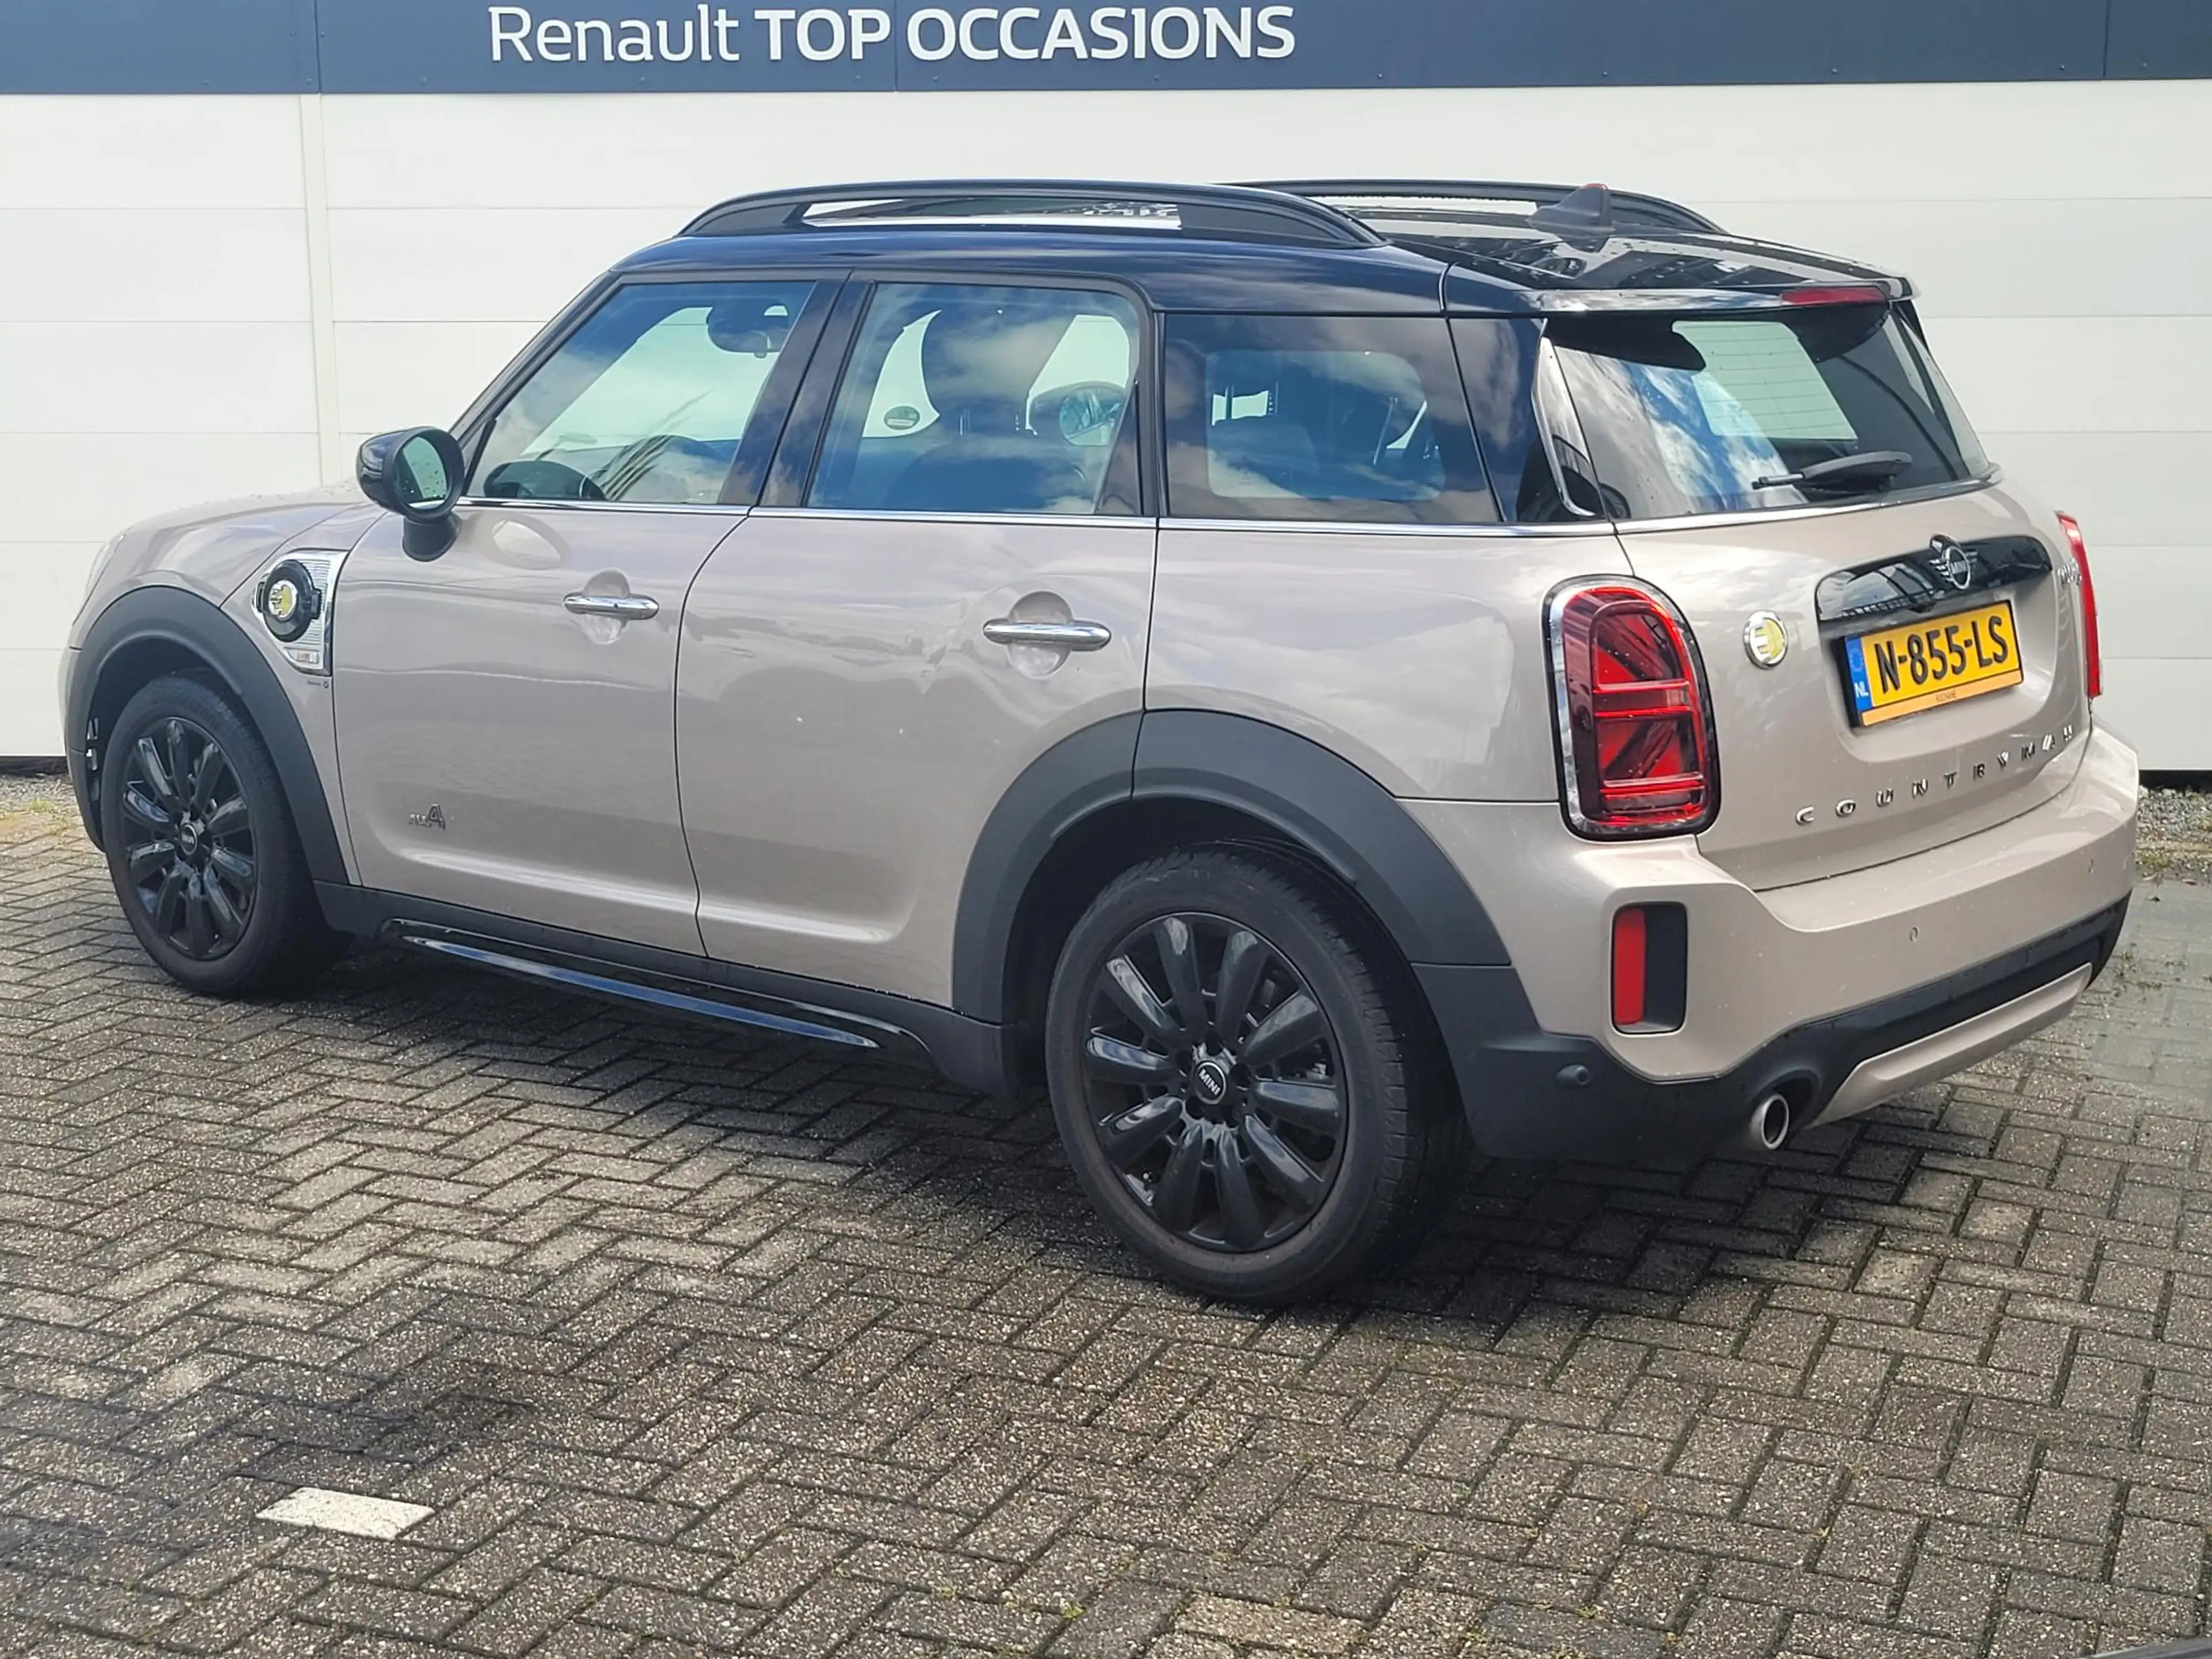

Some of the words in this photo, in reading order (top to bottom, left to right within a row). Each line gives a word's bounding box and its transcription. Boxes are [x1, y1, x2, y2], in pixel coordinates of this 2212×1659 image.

[488, 3, 740, 61] Renault
[753, 8, 892, 61] TOP
[907, 6, 1296, 60] OCCASIONS
[1874, 616, 2008, 694] N-855-LS
[1854, 680, 1869, 698] NL
[1199, 1069, 1221, 1095] MINI
